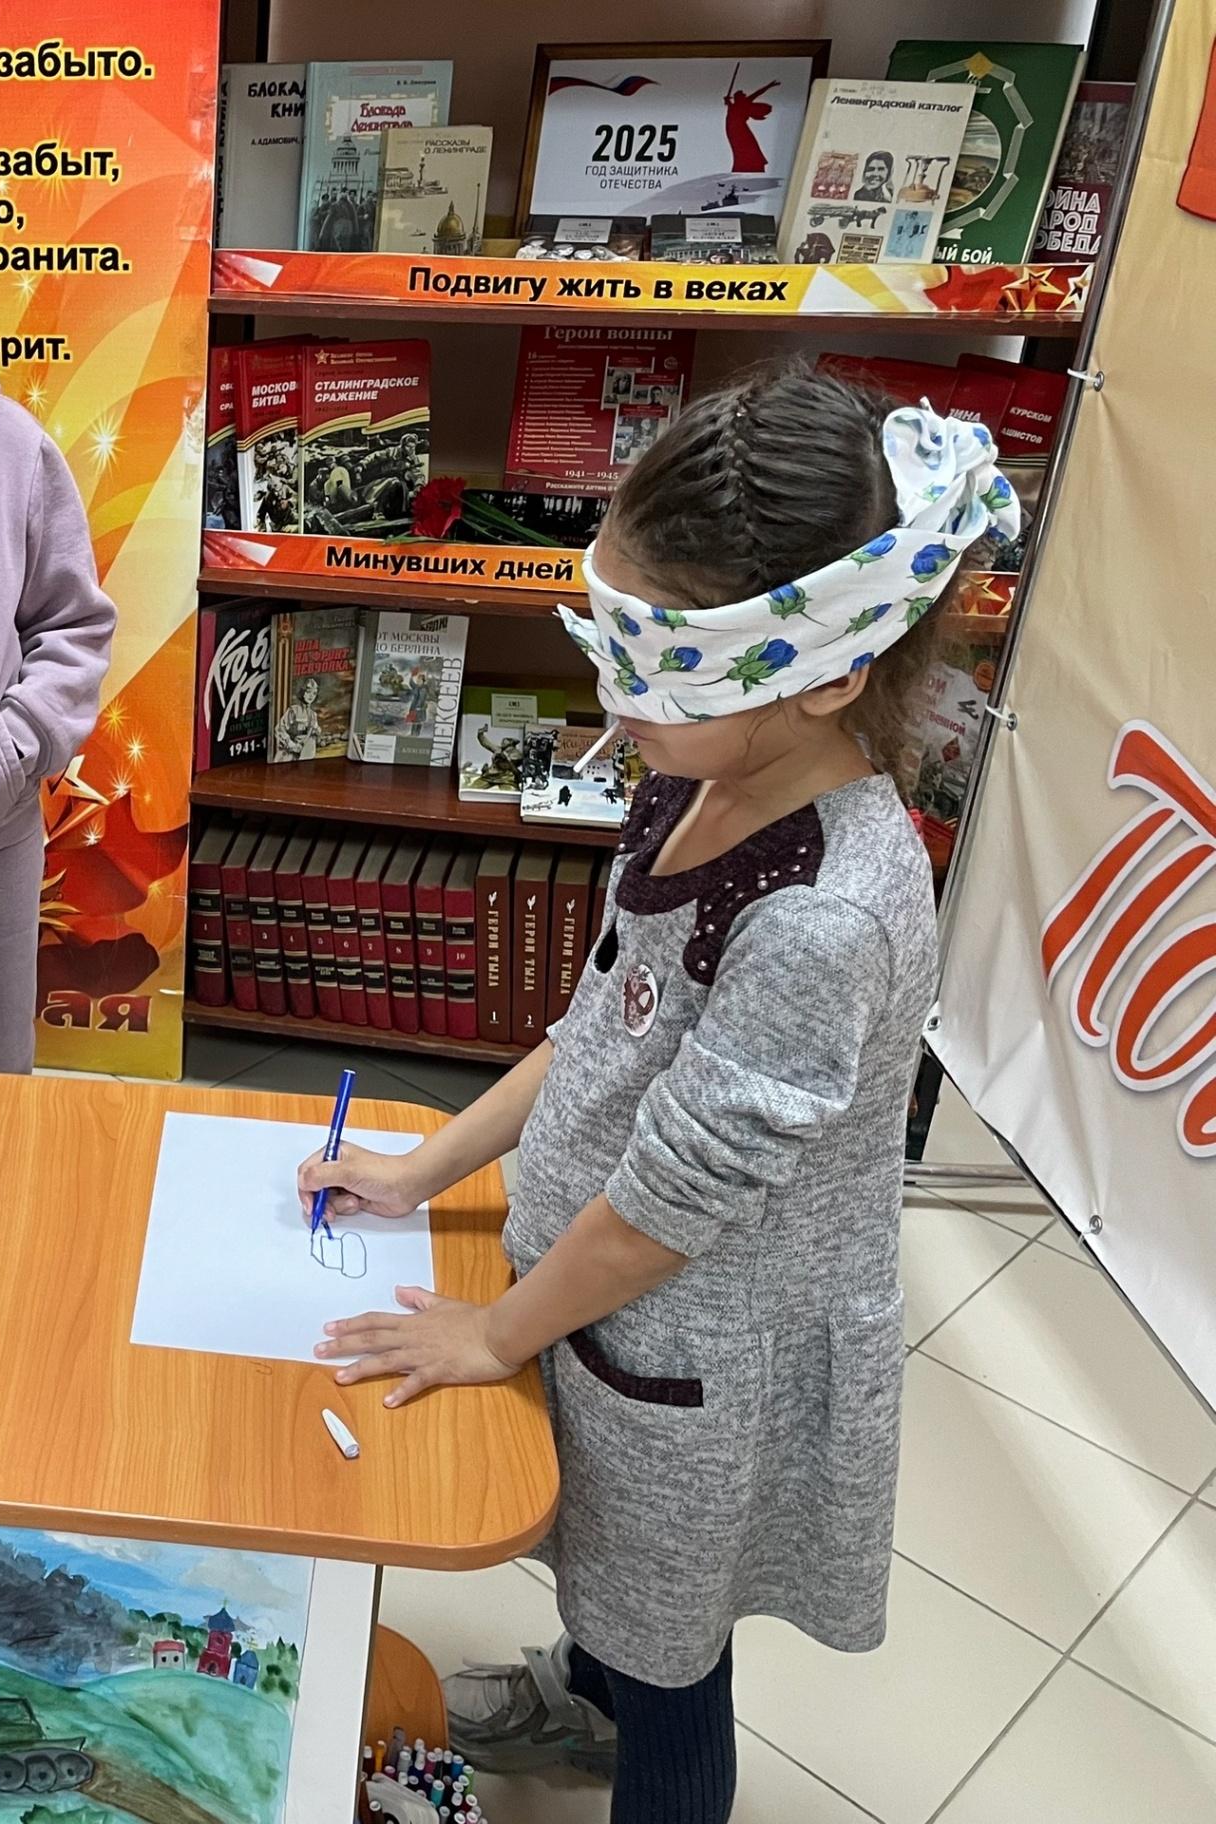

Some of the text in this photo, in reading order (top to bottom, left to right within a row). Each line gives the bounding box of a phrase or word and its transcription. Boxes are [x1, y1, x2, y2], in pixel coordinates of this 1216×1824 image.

[270, 103, 306, 118] КНИ
[360, 102, 407, 117] Блокада
[830, 95, 963, 113] Ленинградский каталог
[425, 138, 471, 147] РАССКАЗЫ
[591, 124, 680, 163] 2025
[585, 165, 679, 179] ГОД ЗАЩИТНИКА
[599, 178, 663, 190] ОТЕЧЕСТВА
[1047, 186, 1101, 214] ЙНА
[1041, 210, 1099, 234] РОД
[409, 266, 788, 302] Подвигу жить в веках
[251, 381, 298, 397] МОСКОВ
[313, 376, 420, 392] СТАЛИНГРАДСКОЕ
[251, 393, 288, 409] БИТВА
[313, 389, 379, 403] СРАЖЕНИЕ
[1009, 406, 1052, 423] КУРСКОМ
[1000, 428, 1044, 445] АШИСТОВ
[564, 469, 586, 479] 1941
[327, 546, 574, 582] Минувших дней
[390, 632, 441, 644] МОСКВЫ
[390, 643, 441, 656] БЕРЛИНА
[229, 738, 267, 757] 1941-1
[487, 910, 500, 949] ГЕРОИ
[524, 913, 536, 953] ГЕРОИ
[561, 916, 576, 957] ГЕРОИ
